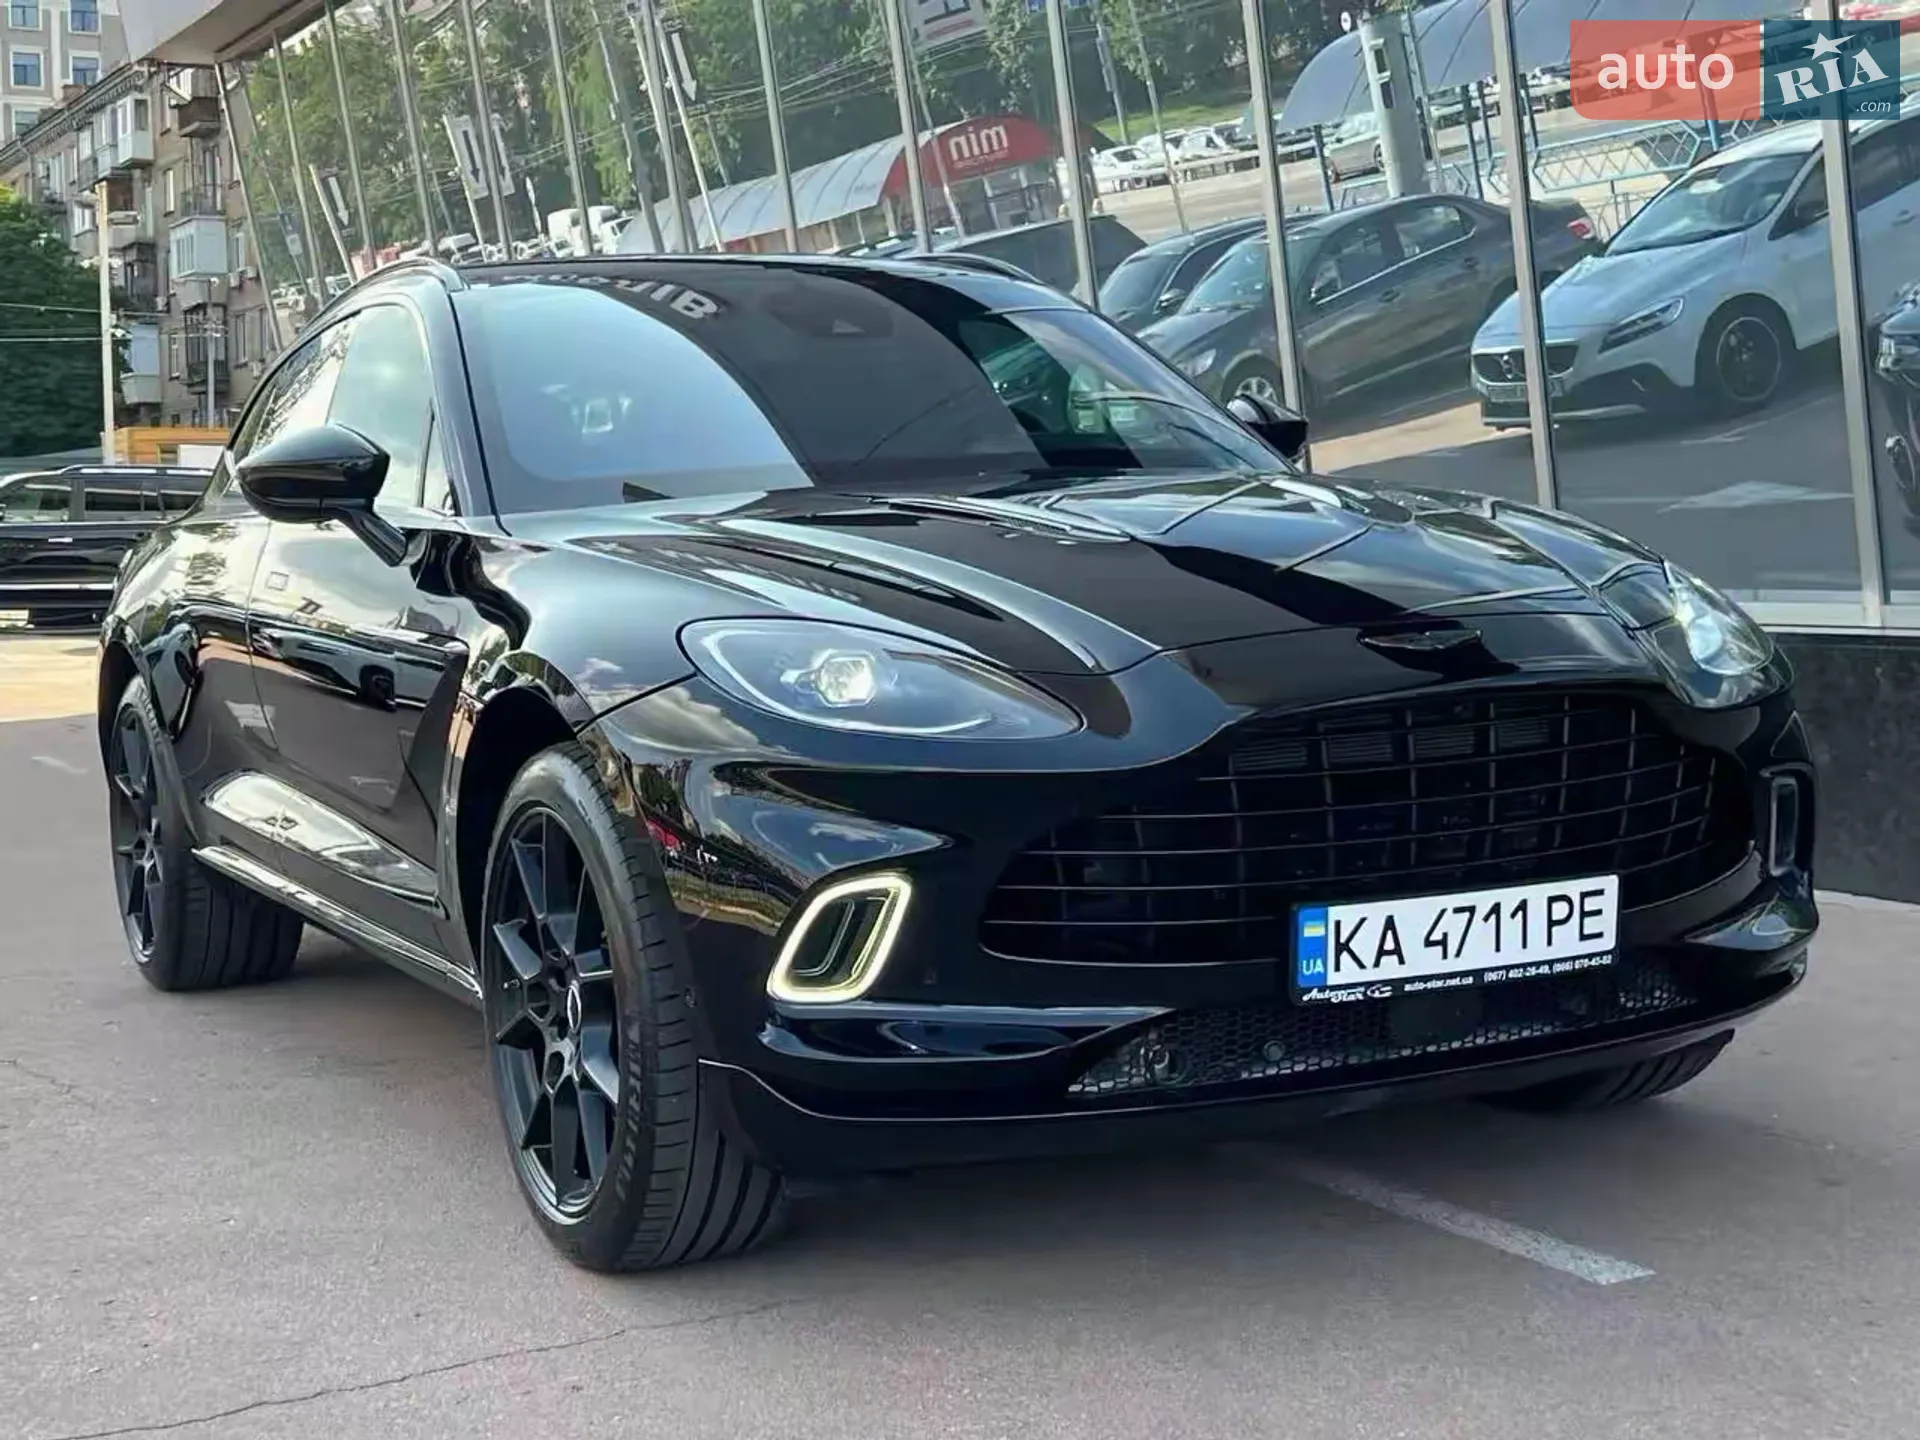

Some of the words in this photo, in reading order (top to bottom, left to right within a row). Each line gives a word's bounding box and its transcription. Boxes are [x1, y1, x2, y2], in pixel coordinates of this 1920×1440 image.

[1333, 914, 1406, 973] KA
[1423, 898, 1529, 961] 4711
[1546, 887, 1606, 947] PE
[1302, 957, 1325, 976] UA
